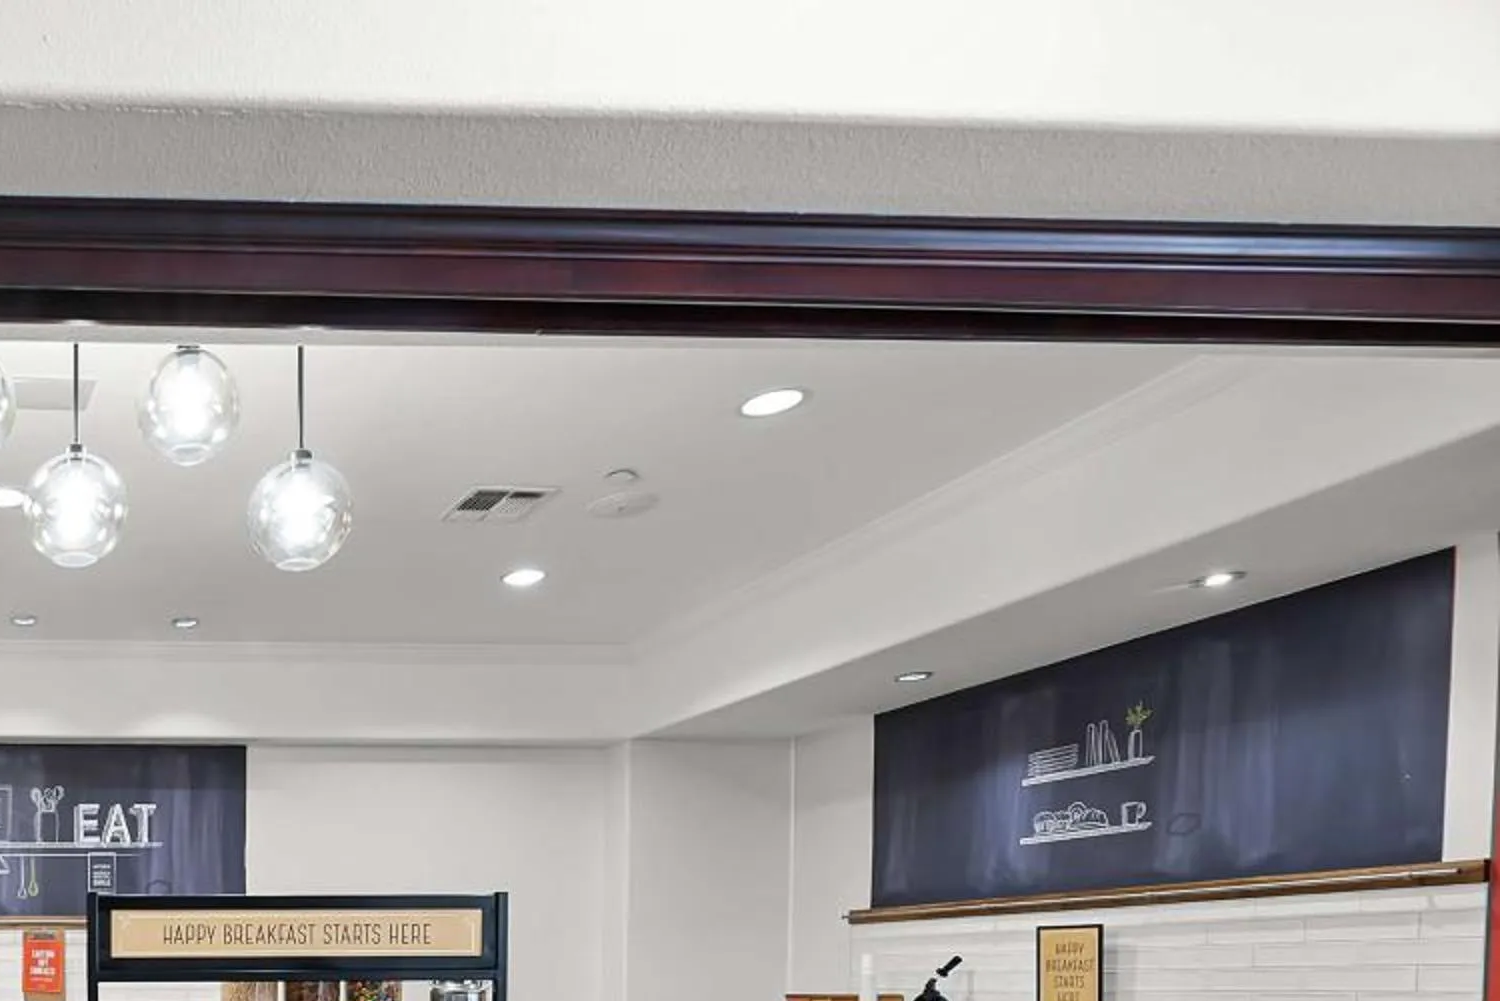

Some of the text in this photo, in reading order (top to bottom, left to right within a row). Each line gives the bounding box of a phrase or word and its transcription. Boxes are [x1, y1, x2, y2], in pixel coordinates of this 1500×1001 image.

[73, 803, 157, 847] EAT
[163, 923, 432, 945] HAPPY BREAKFAST STARTS HERE
[1056, 942, 1084, 954] HAPPY
